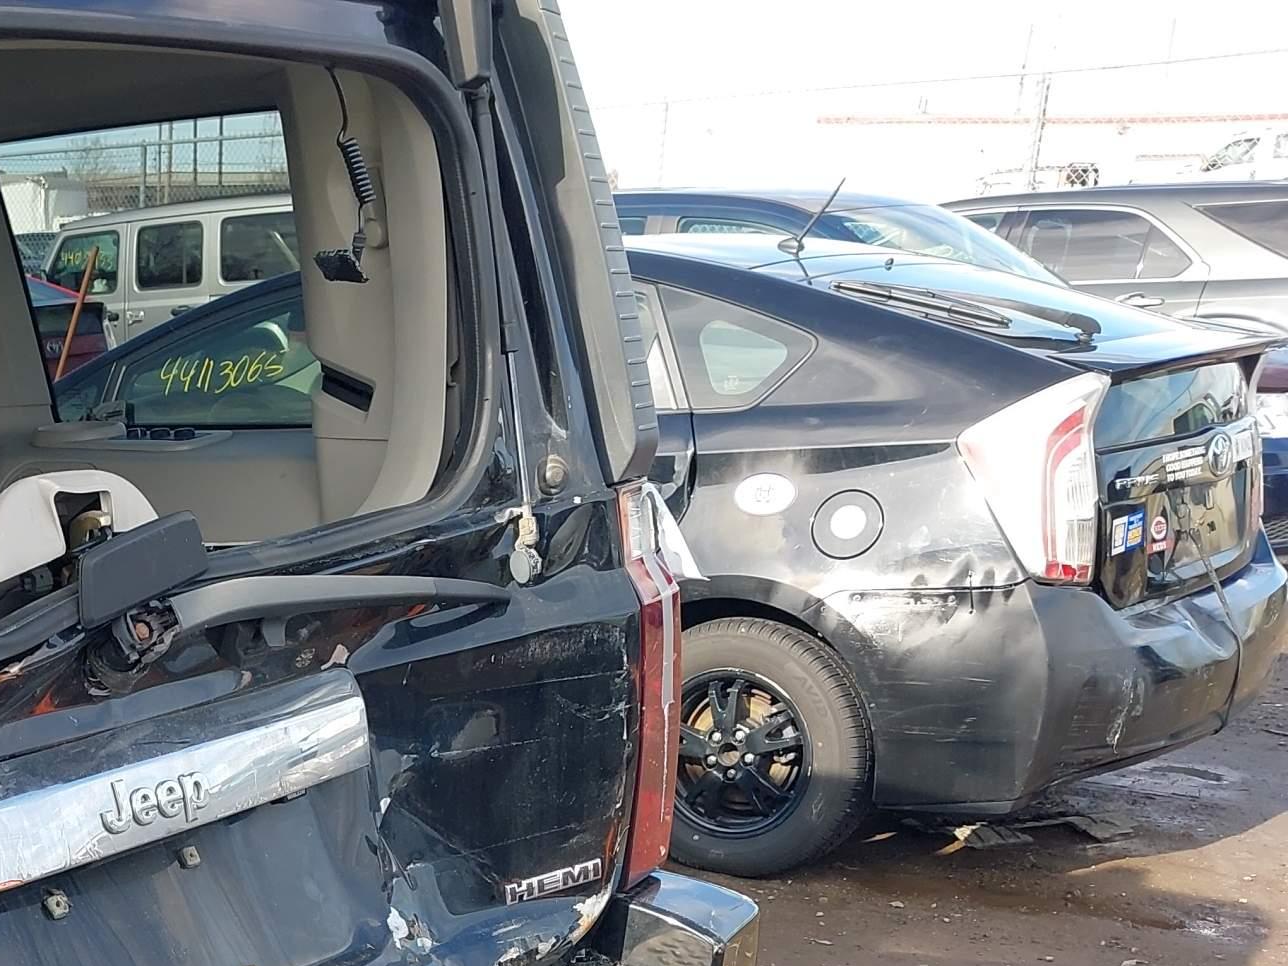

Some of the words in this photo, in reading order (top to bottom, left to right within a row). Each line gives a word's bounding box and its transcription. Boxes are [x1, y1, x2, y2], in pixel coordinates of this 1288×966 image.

[160, 349, 287, 396] 44113065
[99, 771, 209, 834] Jeep
[505, 858, 602, 905] HEMI
